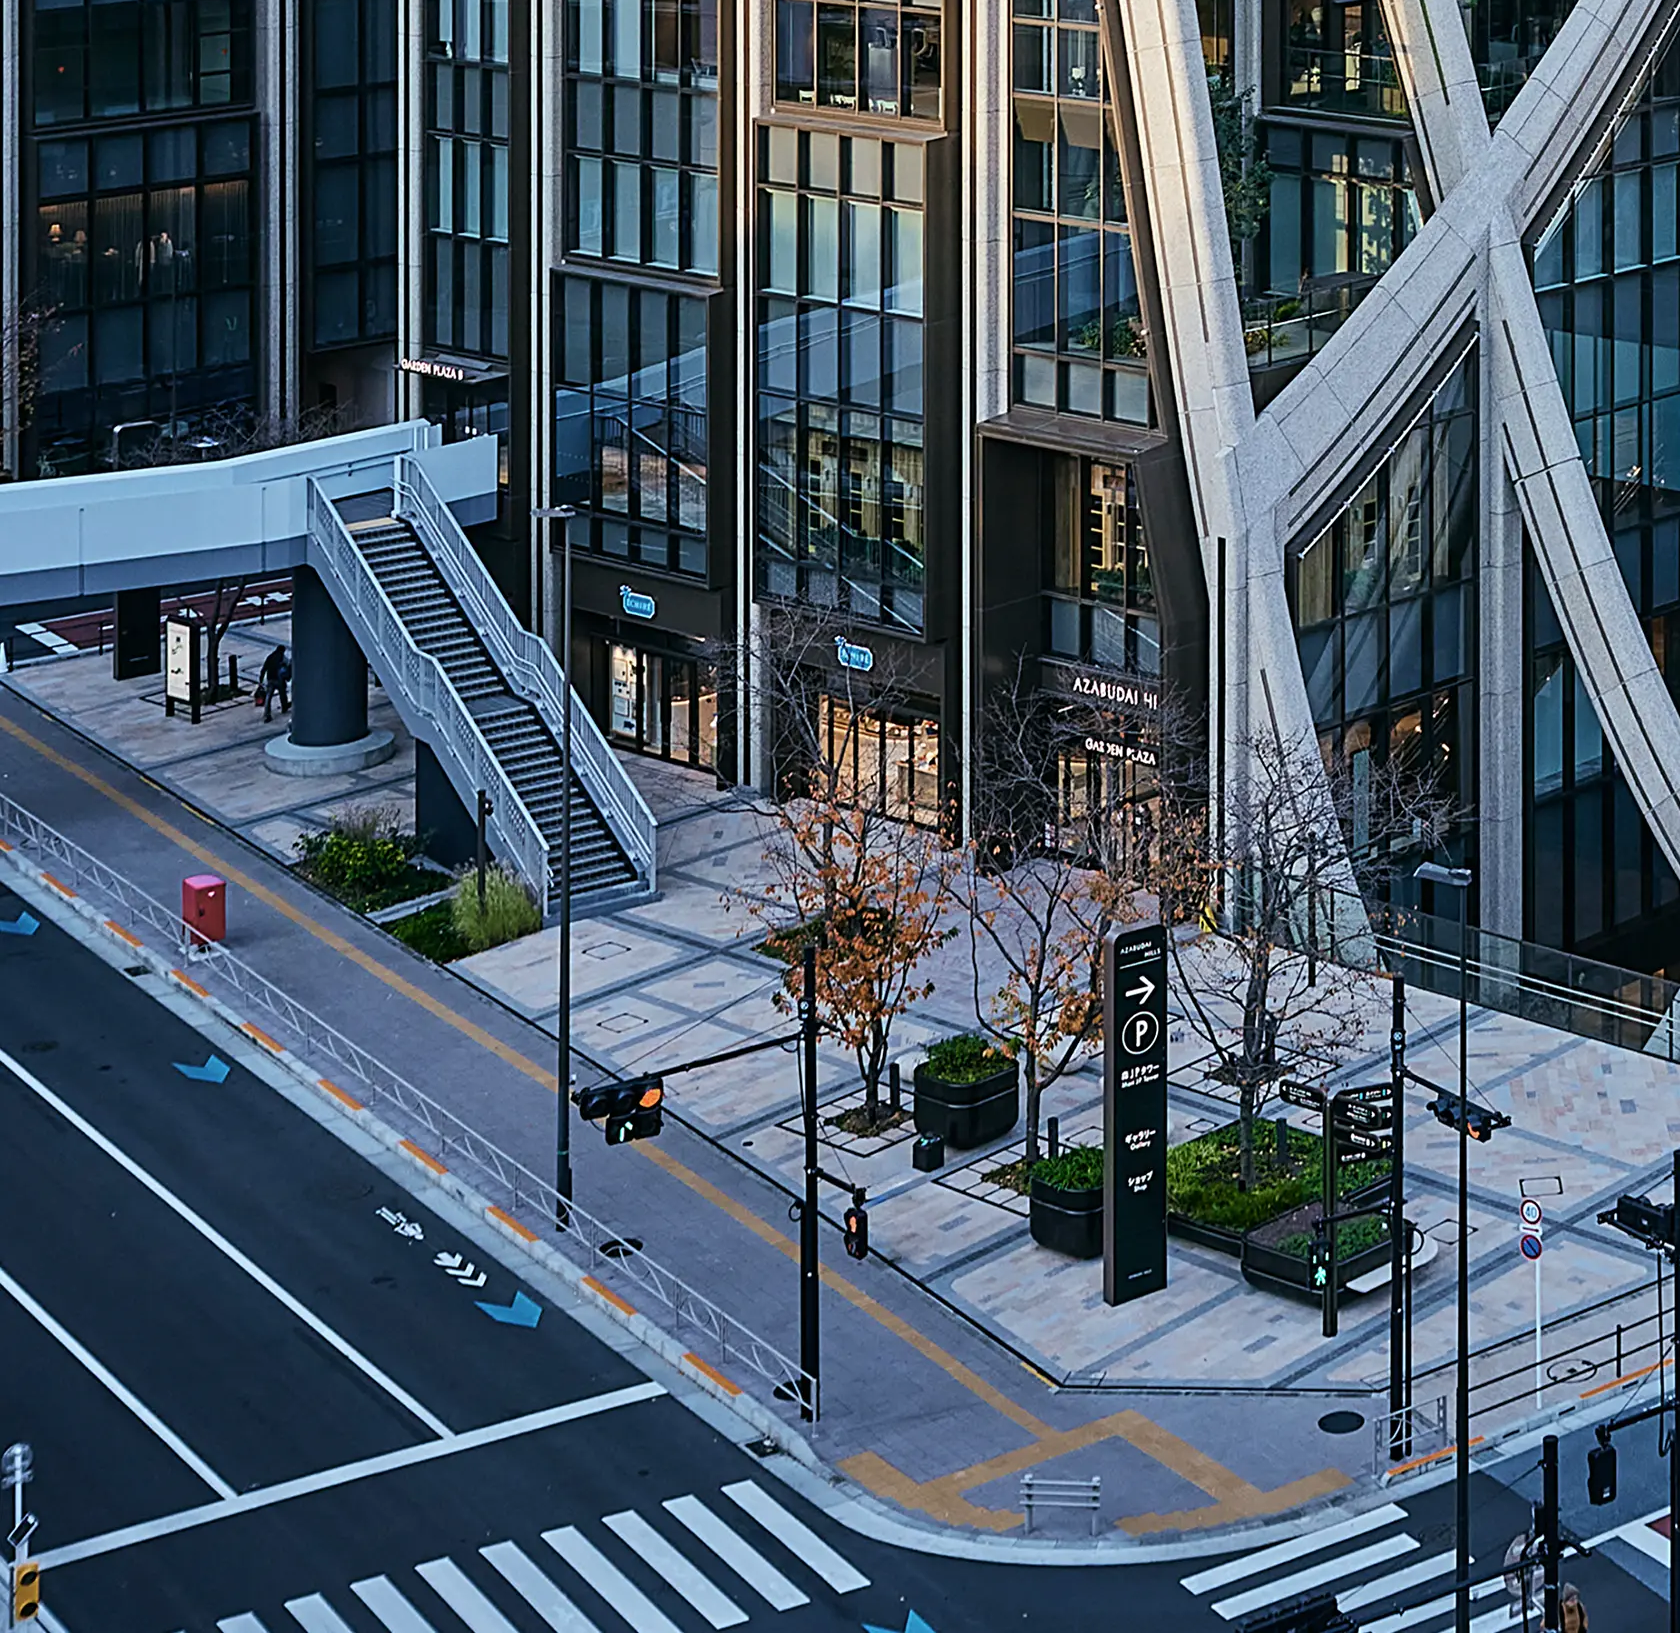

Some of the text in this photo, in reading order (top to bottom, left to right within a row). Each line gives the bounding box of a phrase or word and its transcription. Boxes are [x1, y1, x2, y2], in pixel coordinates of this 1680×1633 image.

[401, 358, 432, 375] GARDEN
[433, 364, 457, 380] PLAZA
[1072, 676, 1139, 706] AZABUDAI
[1136, 1019, 1149, 1048] P
[1525, 1205, 1538, 1219] 40
